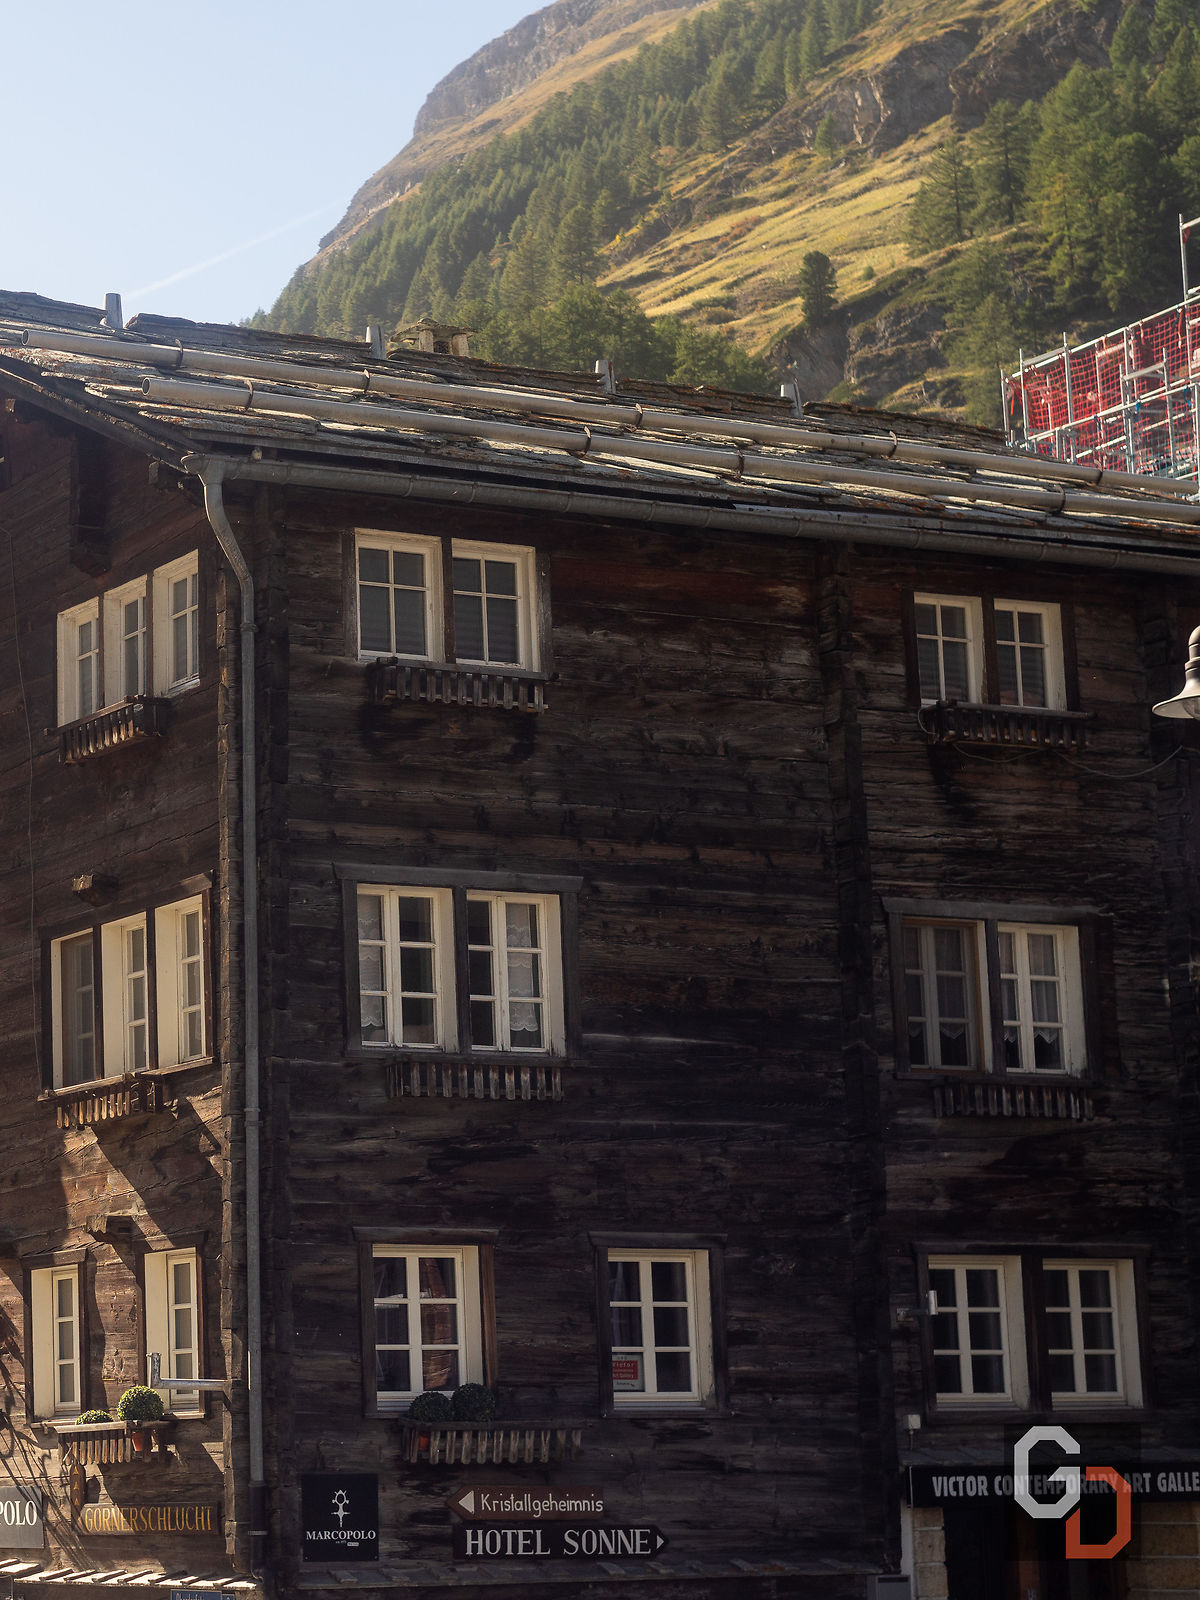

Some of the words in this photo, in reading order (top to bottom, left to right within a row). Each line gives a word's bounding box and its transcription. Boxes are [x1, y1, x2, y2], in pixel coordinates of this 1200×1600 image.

[931, 1474, 989, 1497] VICTOR
[994, 1472, 1118, 1496] CONTEMPORARY
[1122, 1472, 1152, 1493] ART
[1157, 1471, 1200, 1493] GALLE
[481, 1492, 604, 1518] Kristallgeheimnis
[85, 1505, 213, 1532] GORNERSCHLUCHT
[306, 1530, 376, 1540] MARCOPOLO
[465, 1529, 550, 1556] HOTEL
[563, 1528, 652, 1556] SONNE
